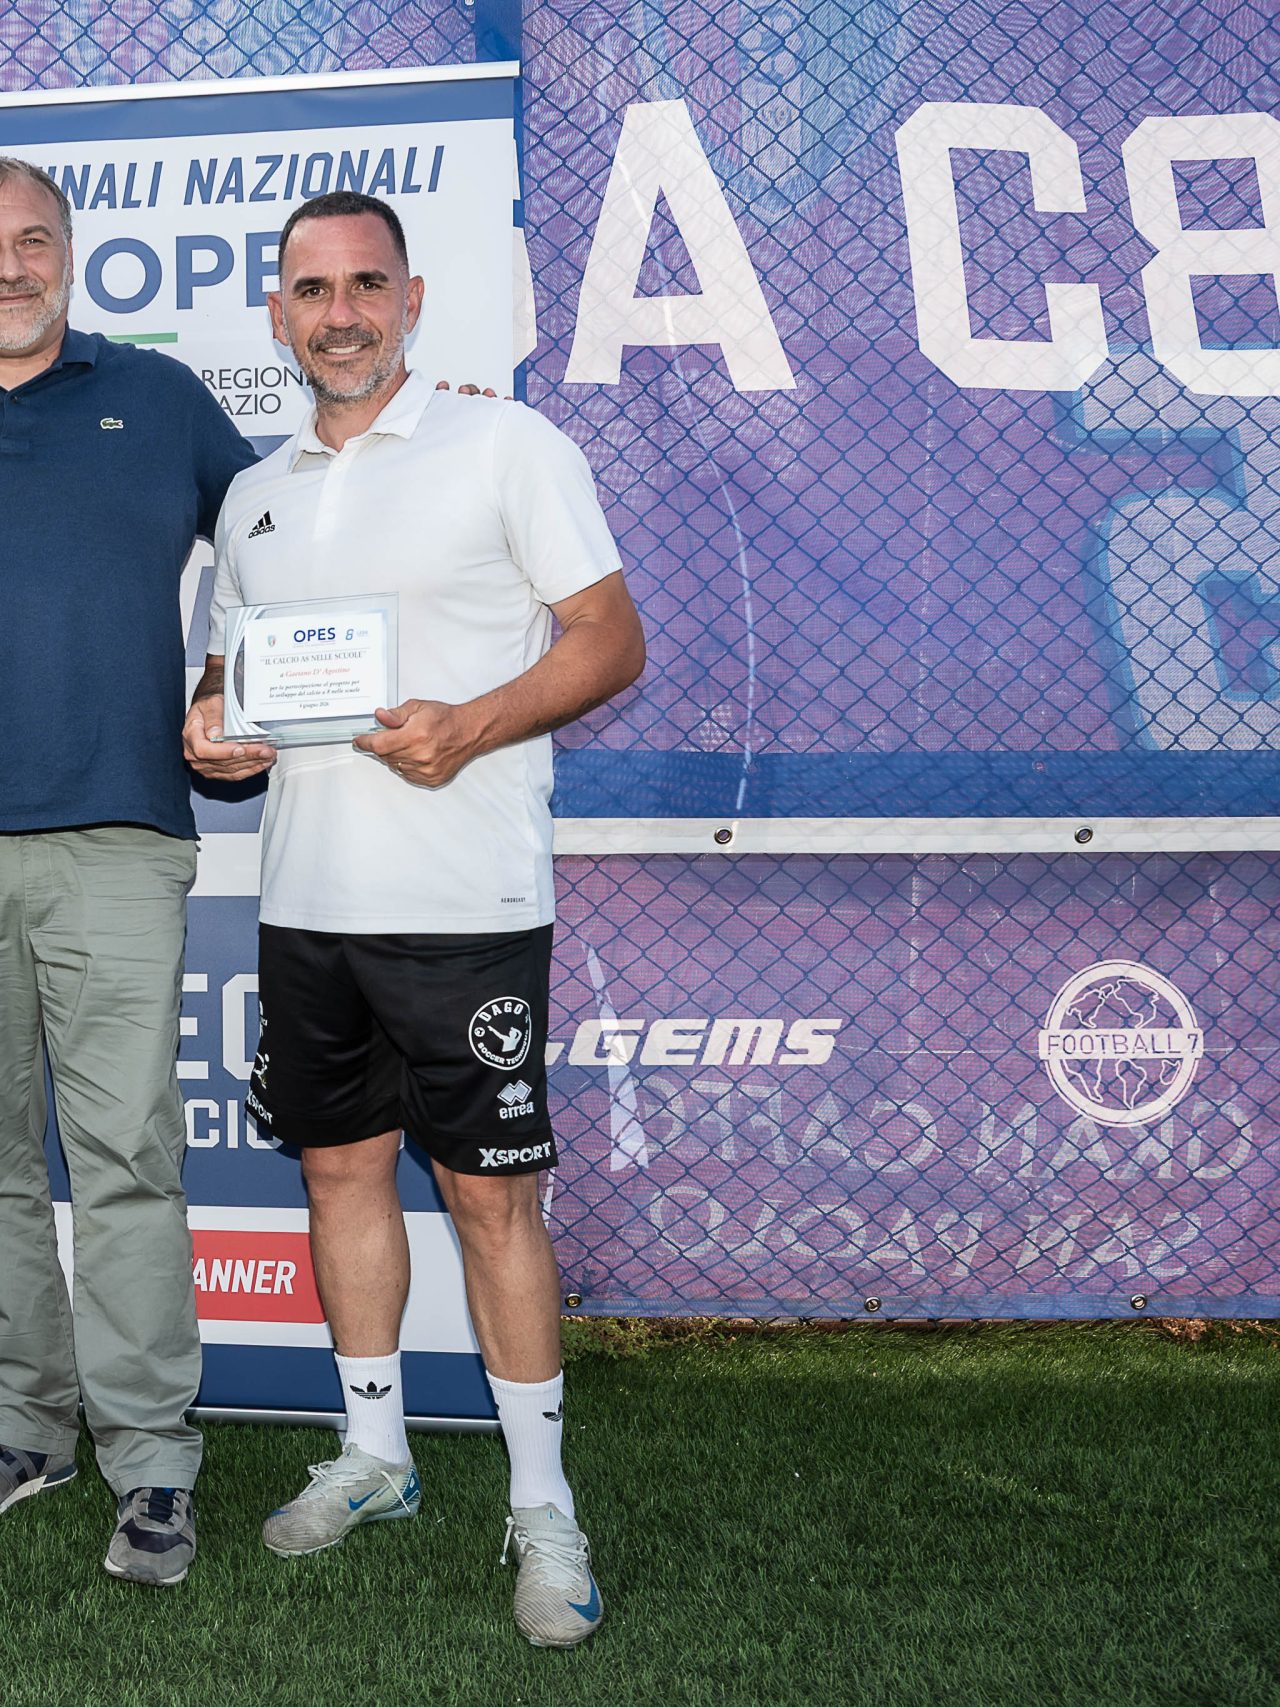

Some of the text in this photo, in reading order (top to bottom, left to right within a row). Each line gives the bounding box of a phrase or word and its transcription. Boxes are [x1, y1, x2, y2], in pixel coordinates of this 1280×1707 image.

[183, 145, 445, 207] NAZIONALI
[513, 98, 1280, 397] A C8
[84, 230, 283, 315] OPE
[201, 366, 312, 390] REGION
[220, 393, 282, 416] AZIO
[248, 524, 276, 539] adidas
[293, 627, 336, 643] OPES
[272, 655, 299, 665] CALCIO
[311, 652, 333, 662] NELLE
[478, 1001, 524, 1022] DAGO
[477, 1042, 505, 1065] SOCCER
[1047, 1032, 1199, 1055] FOOTBALL 7
[478, 1141, 551, 1168] XSPORT
[192, 1258, 297, 1295] ANNER
